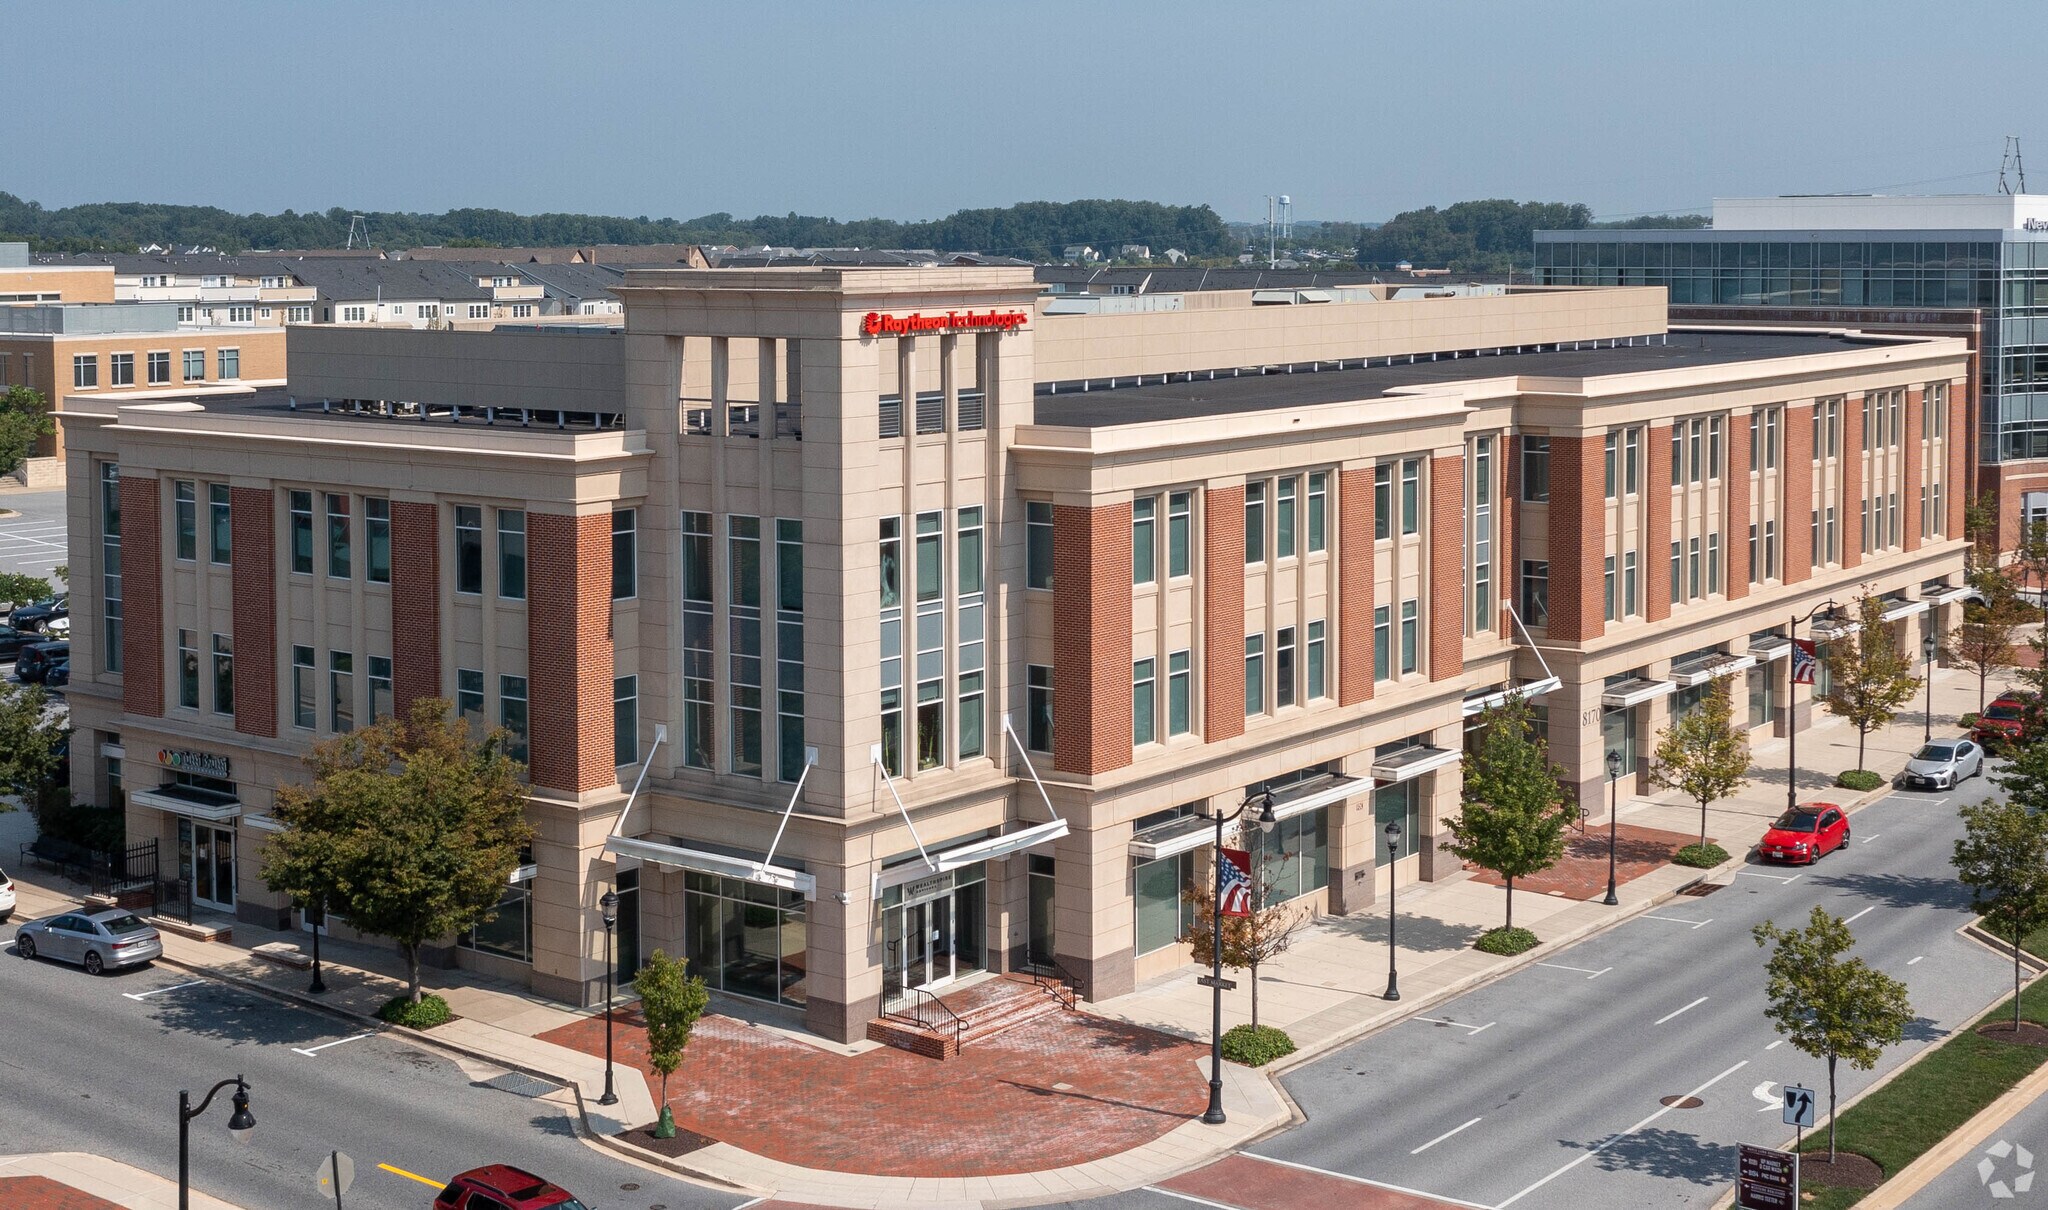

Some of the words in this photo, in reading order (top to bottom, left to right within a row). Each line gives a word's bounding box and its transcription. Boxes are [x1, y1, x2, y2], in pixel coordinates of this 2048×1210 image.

[882, 313, 948, 334] Raytheon
[946, 310, 1028, 330] Technologies
[1583, 707, 1601, 726] 8170
